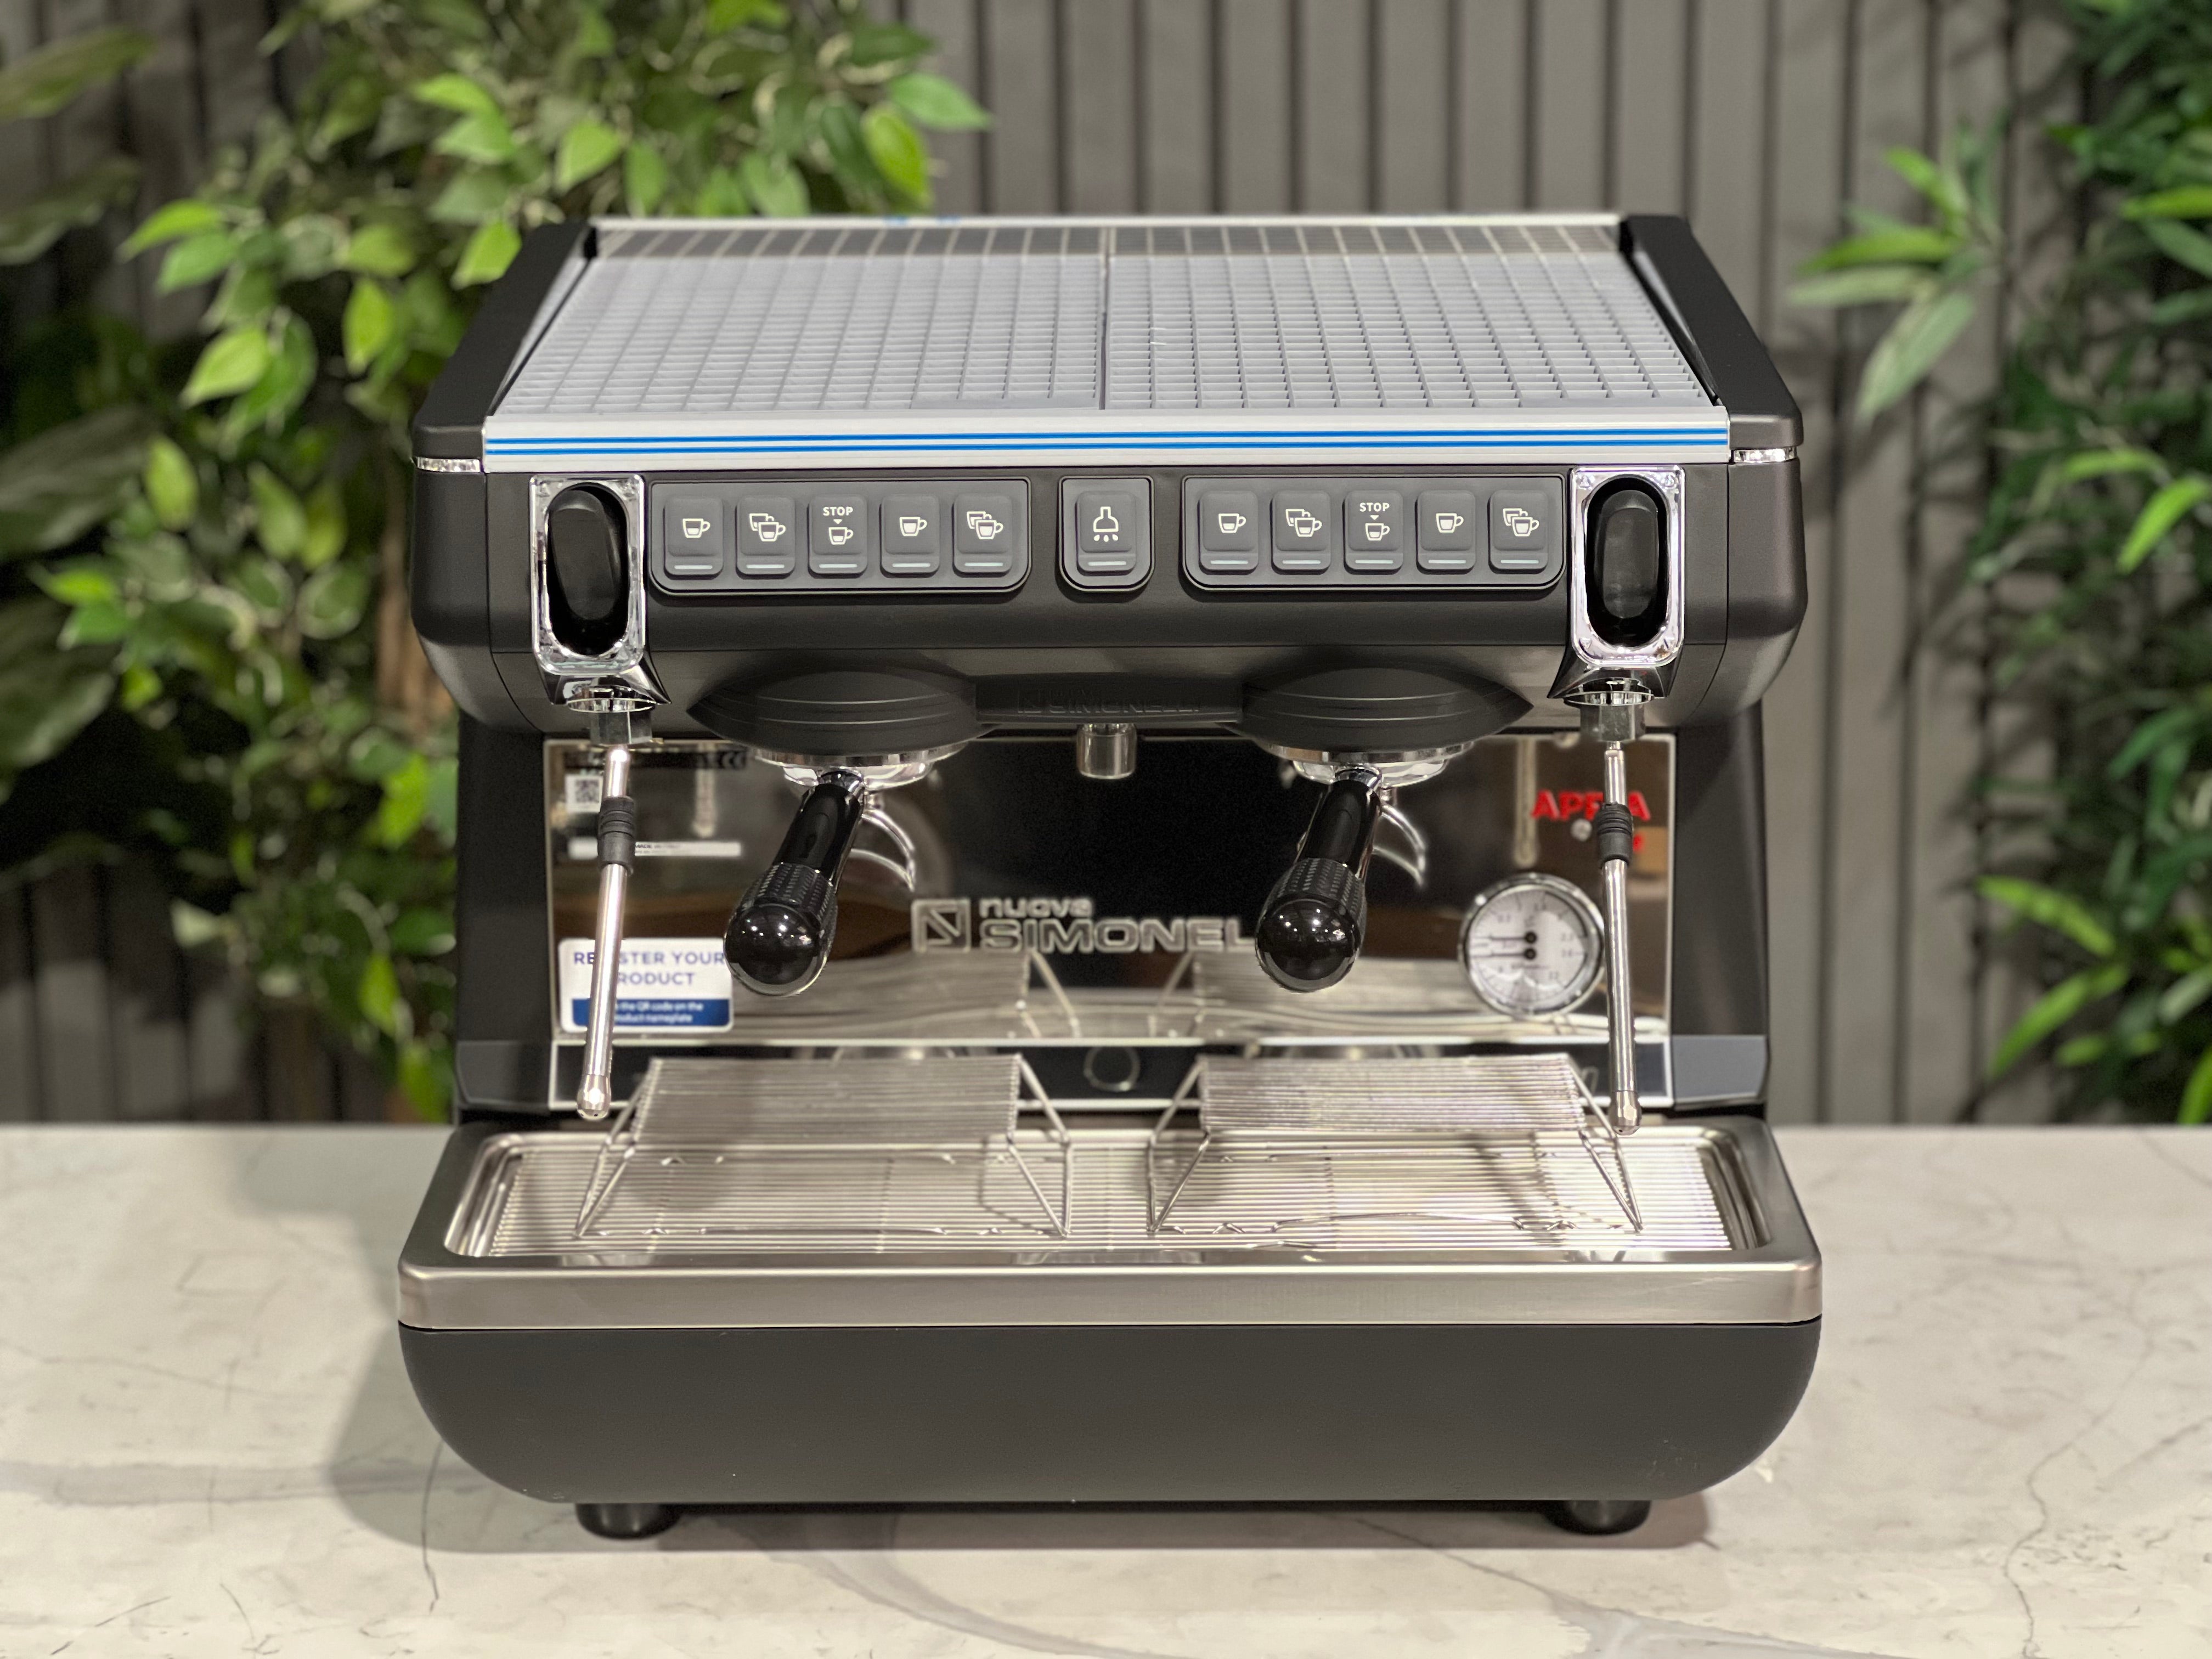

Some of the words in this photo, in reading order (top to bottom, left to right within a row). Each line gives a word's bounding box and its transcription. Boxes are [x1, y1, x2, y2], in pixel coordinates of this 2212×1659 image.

[823, 506, 853, 516] STOP
[1359, 502, 1390, 512] STOP
[1531, 789, 1651, 821] APPA
[979, 898, 1093, 918] nuova
[979, 918, 1257, 953] SIMONEL
[574, 952, 664, 964] RESTER
[672, 952, 725, 964] YOUR
[618, 972, 695, 985] RODUCT
